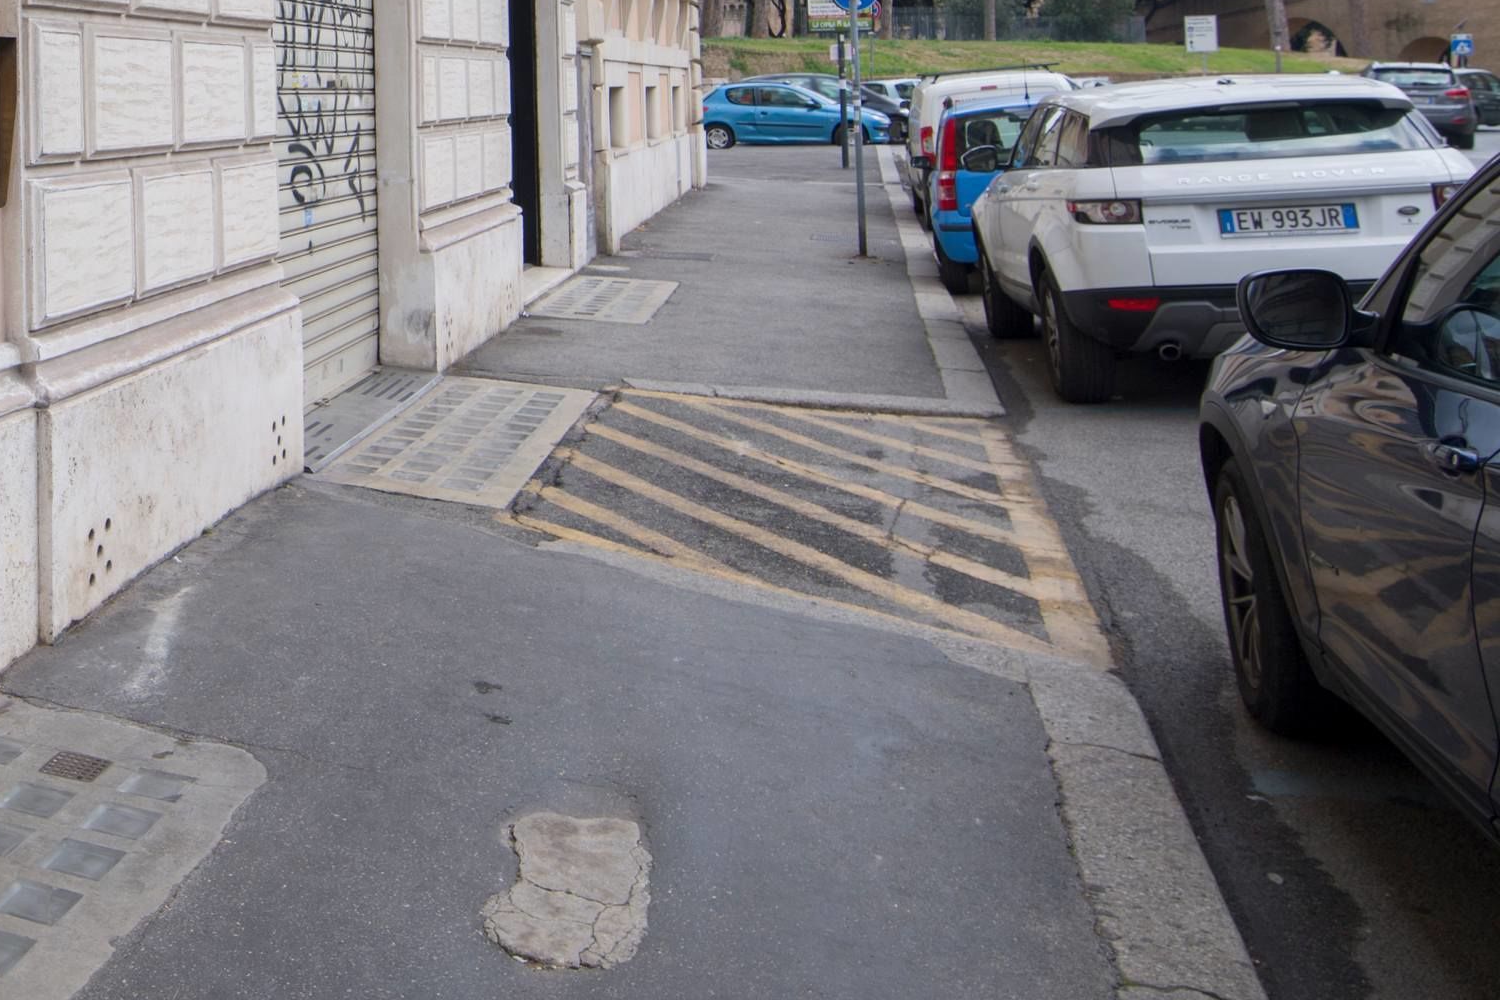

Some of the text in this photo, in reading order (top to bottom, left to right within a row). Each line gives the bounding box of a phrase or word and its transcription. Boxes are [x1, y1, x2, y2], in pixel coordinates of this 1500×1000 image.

[1177, 166, 1386, 186] RANGE ROVER
[1236, 211, 1263, 231] EW
[1271, 207, 1342, 229] 993JR
